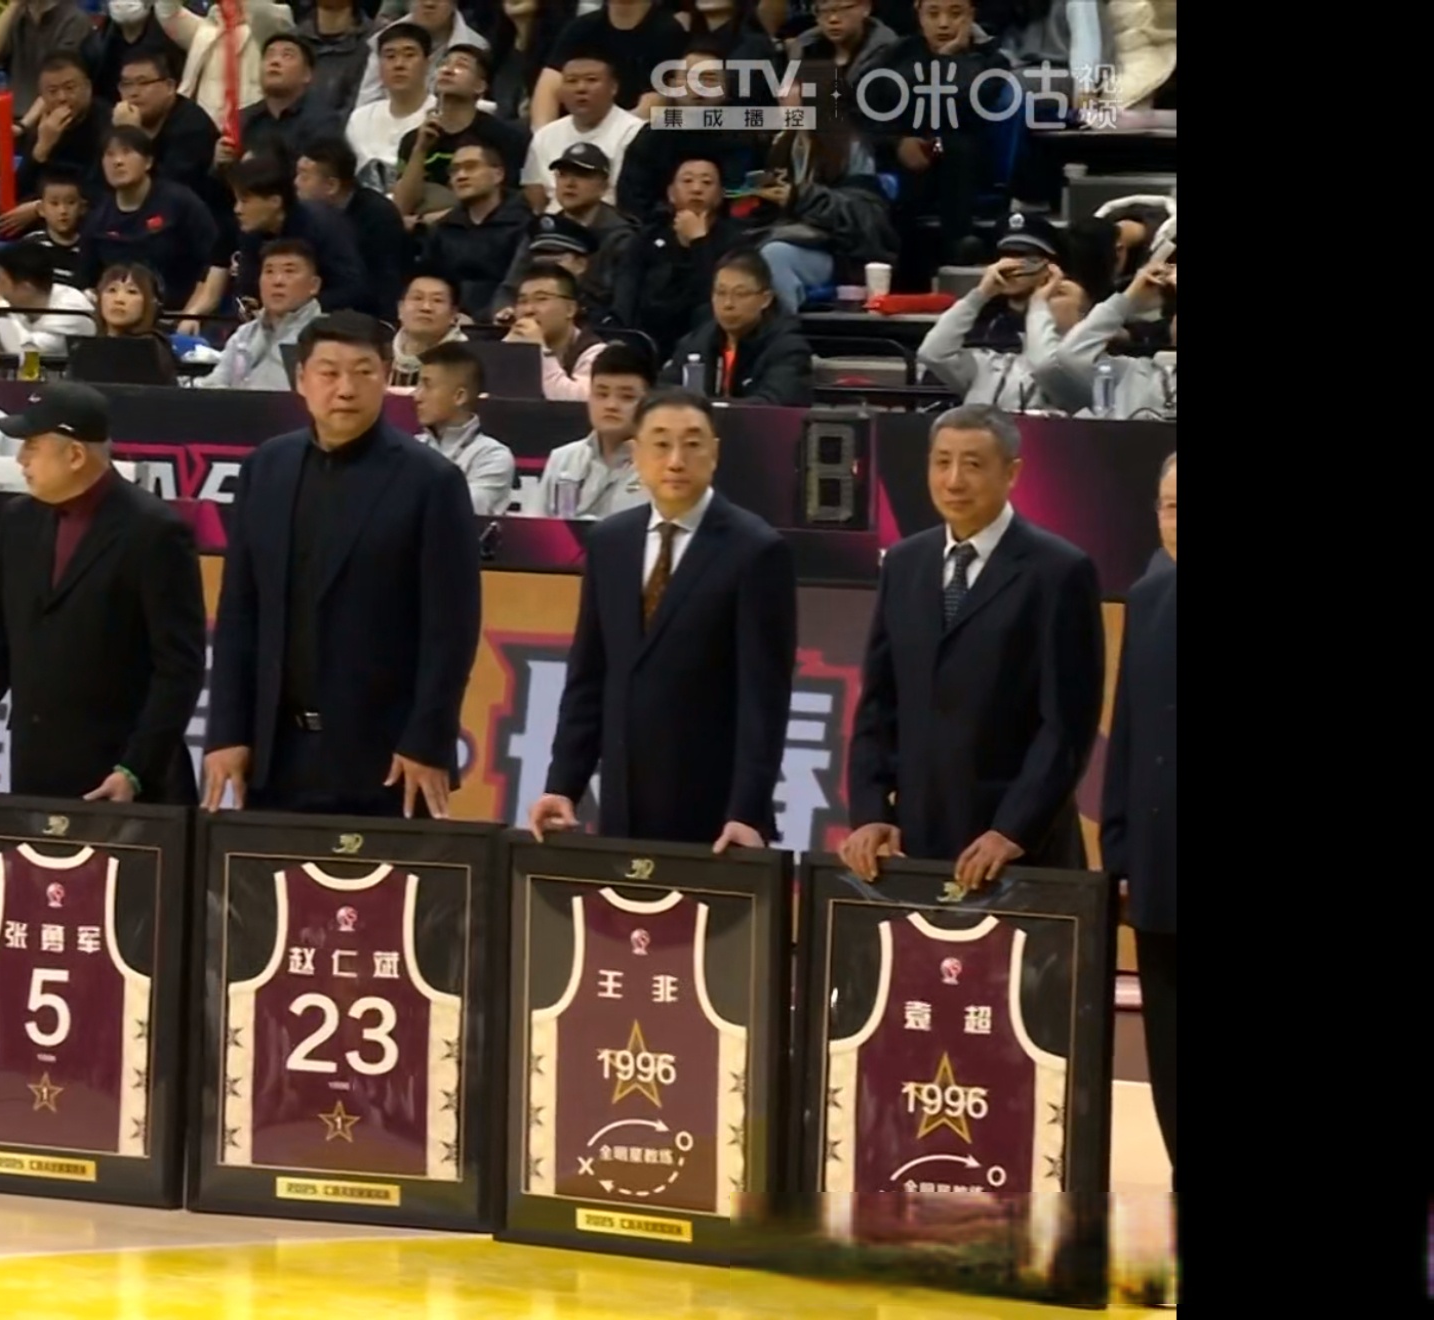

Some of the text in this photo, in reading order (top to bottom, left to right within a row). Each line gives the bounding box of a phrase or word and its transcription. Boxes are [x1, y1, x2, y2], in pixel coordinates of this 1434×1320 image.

[289, 947, 399, 978] 赵仁斌
[598, 970, 677, 1002] 王非
[26, 969, 69, 1045] 5
[905, 1001, 991, 1033] 袁超
[287, 994, 397, 1074] 23
[597, 1050, 677, 1086] 1996
[901, 1083, 989, 1119] 1996
